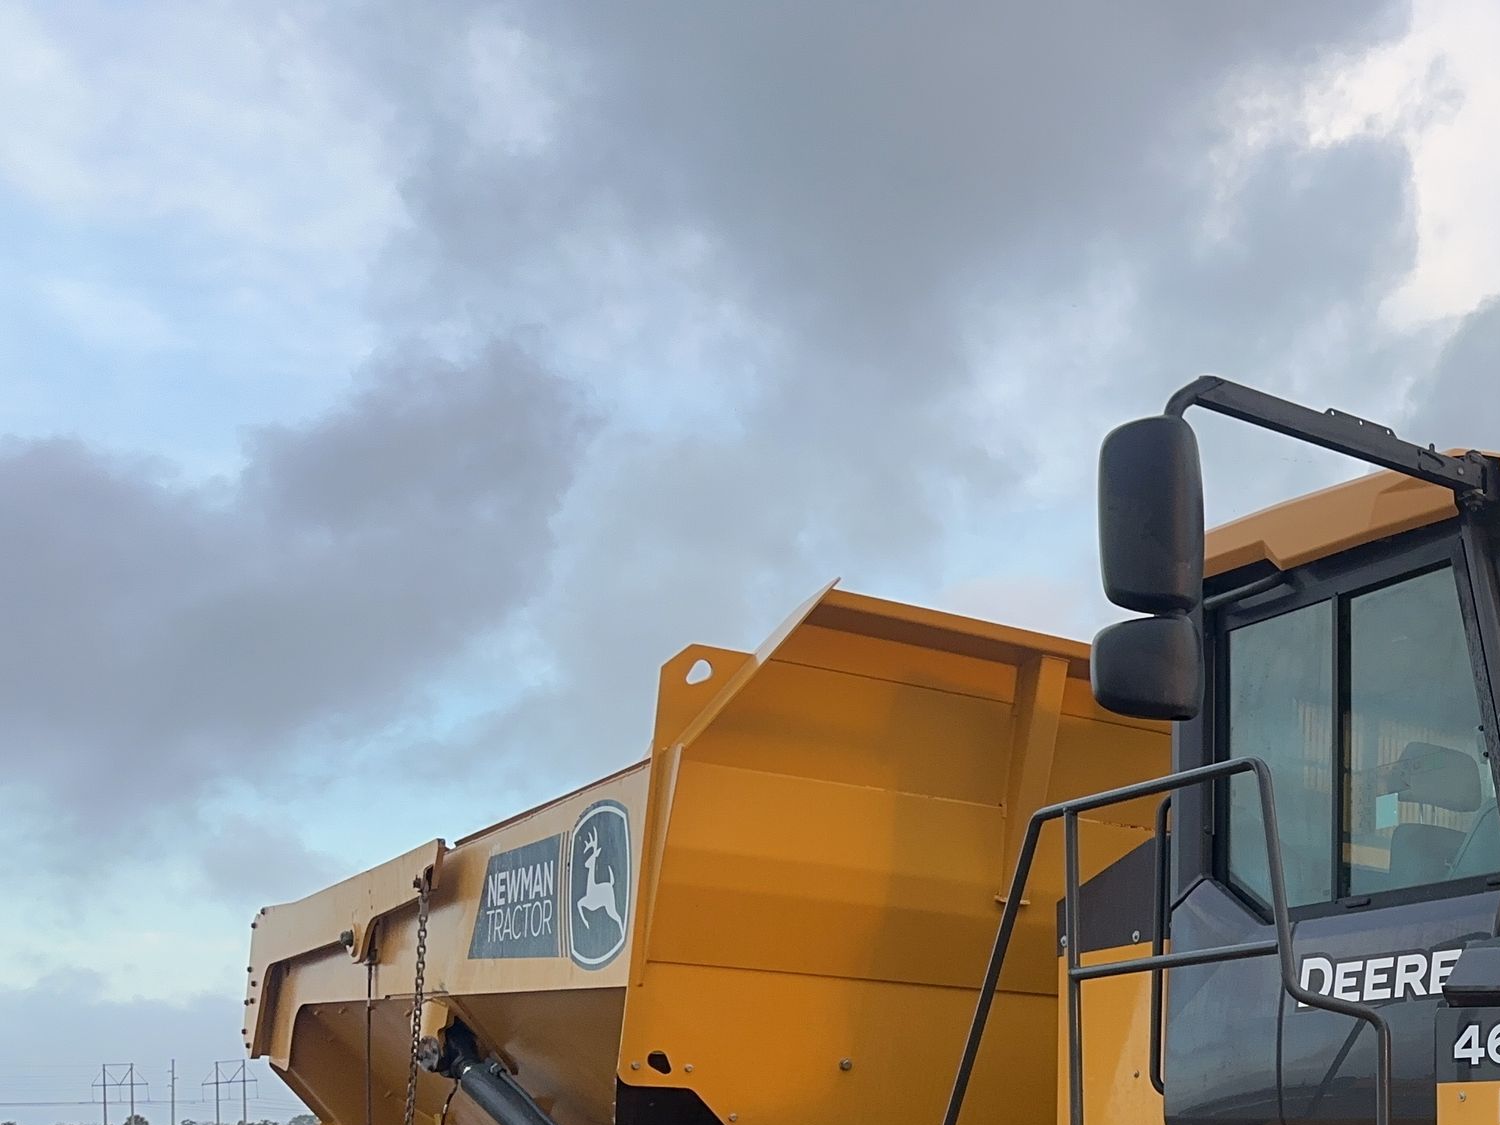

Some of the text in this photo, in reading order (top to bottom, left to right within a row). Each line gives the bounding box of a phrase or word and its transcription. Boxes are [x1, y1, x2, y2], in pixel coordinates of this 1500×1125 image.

[487, 860, 554, 908] NEWMAN
[487, 900, 553, 943] TRACTOR
[1298, 949, 1462, 1007] DEERE
